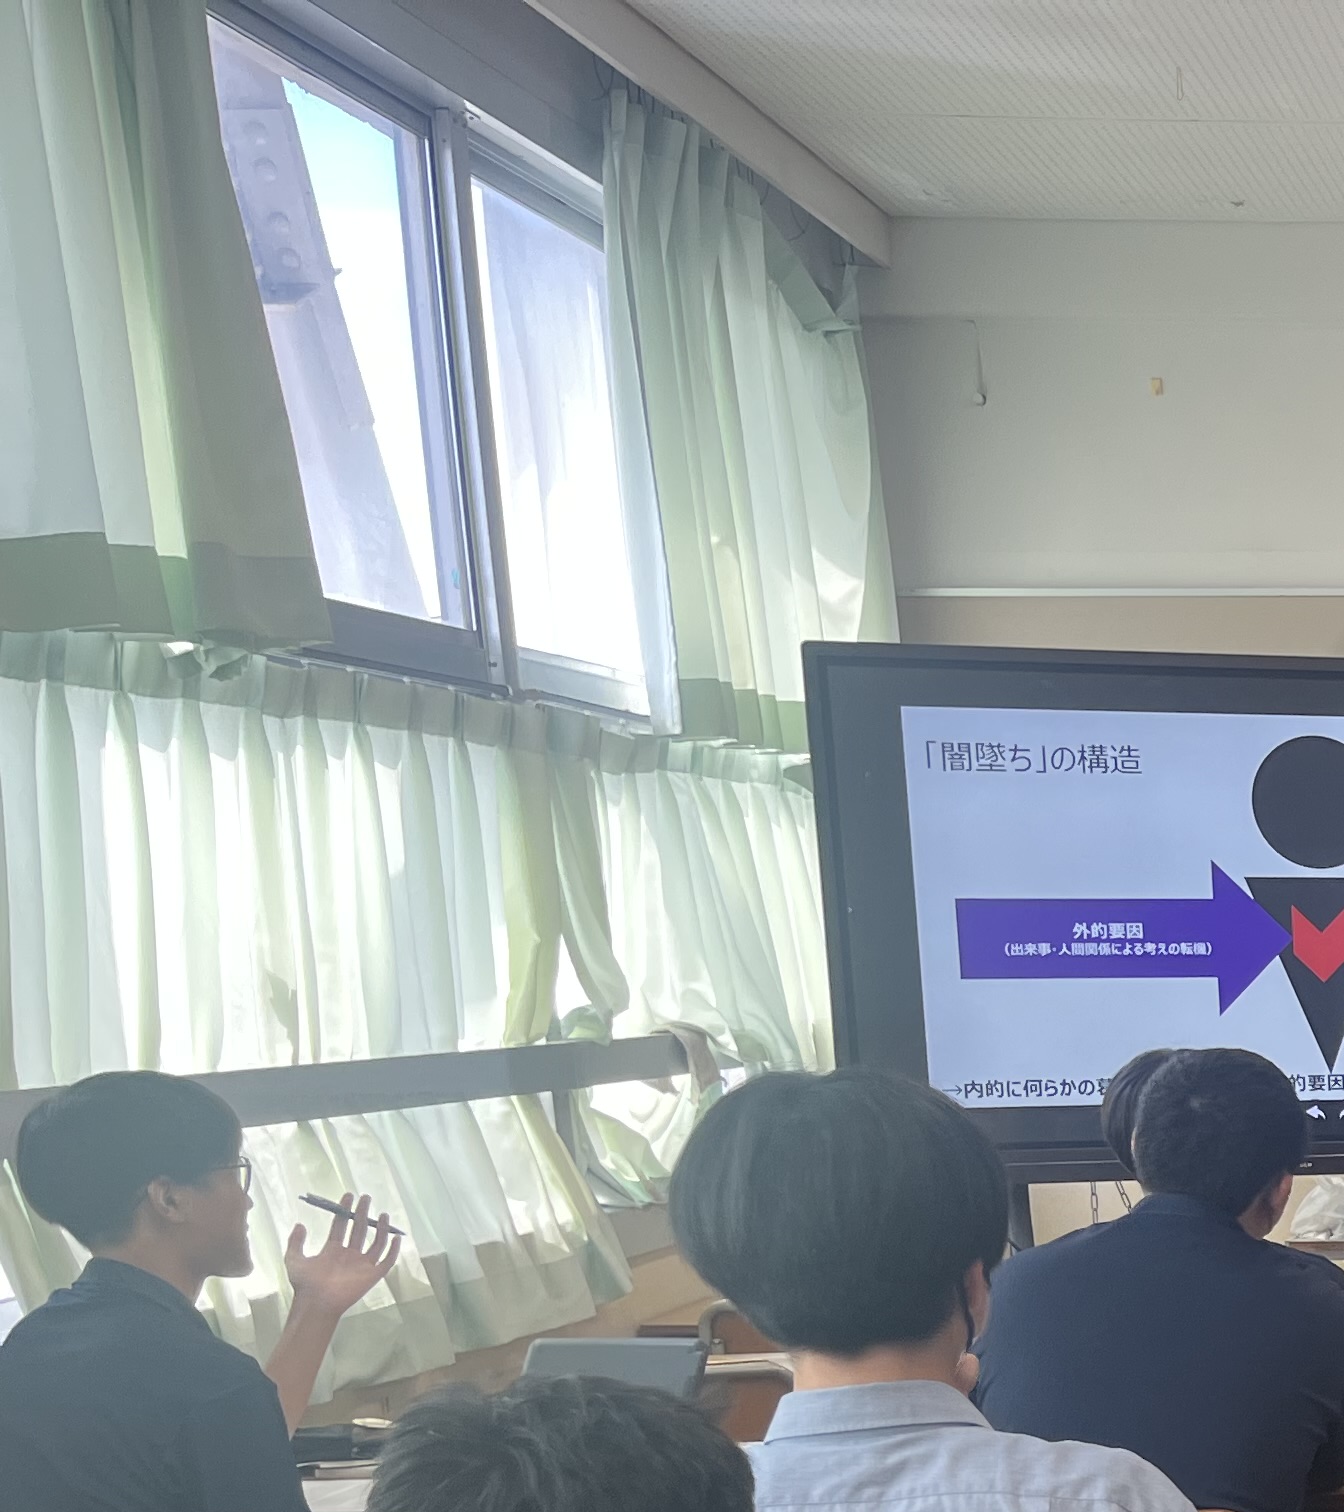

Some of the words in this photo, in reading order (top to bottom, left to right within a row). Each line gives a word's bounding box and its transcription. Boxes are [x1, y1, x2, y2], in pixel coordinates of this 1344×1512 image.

[925, 740, 1143, 774] 「闇墜ち」の構造
[1072, 922, 1144, 940] 外的要因
